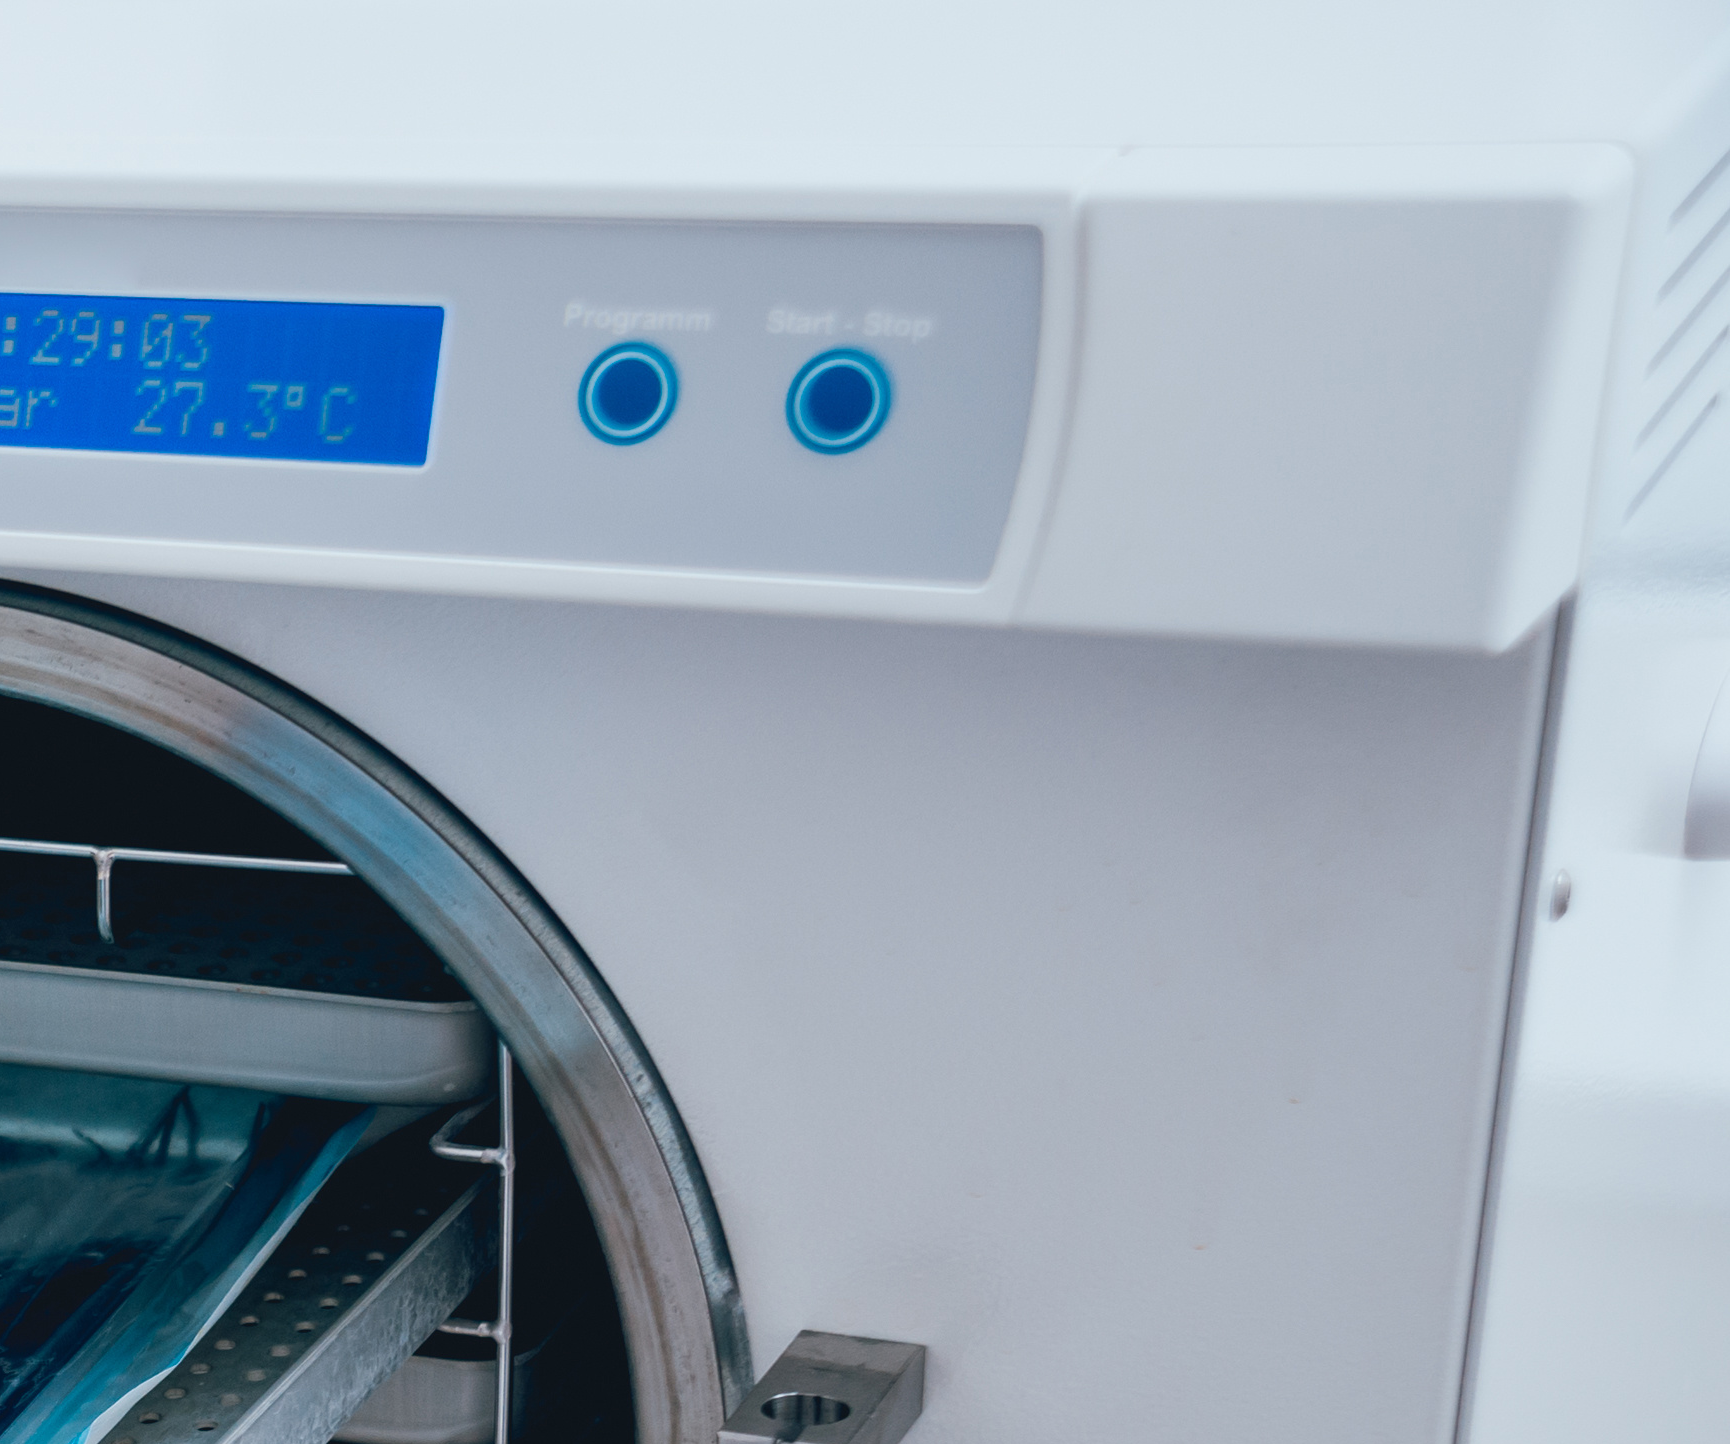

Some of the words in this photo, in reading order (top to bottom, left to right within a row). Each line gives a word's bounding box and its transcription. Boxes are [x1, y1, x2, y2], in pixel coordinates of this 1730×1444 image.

[563, 301, 711, 335] Programm
[765, 308, 836, 335] Start
[862, 310, 933, 344] Stop
[133, 379, 354, 442] 27.3°C
